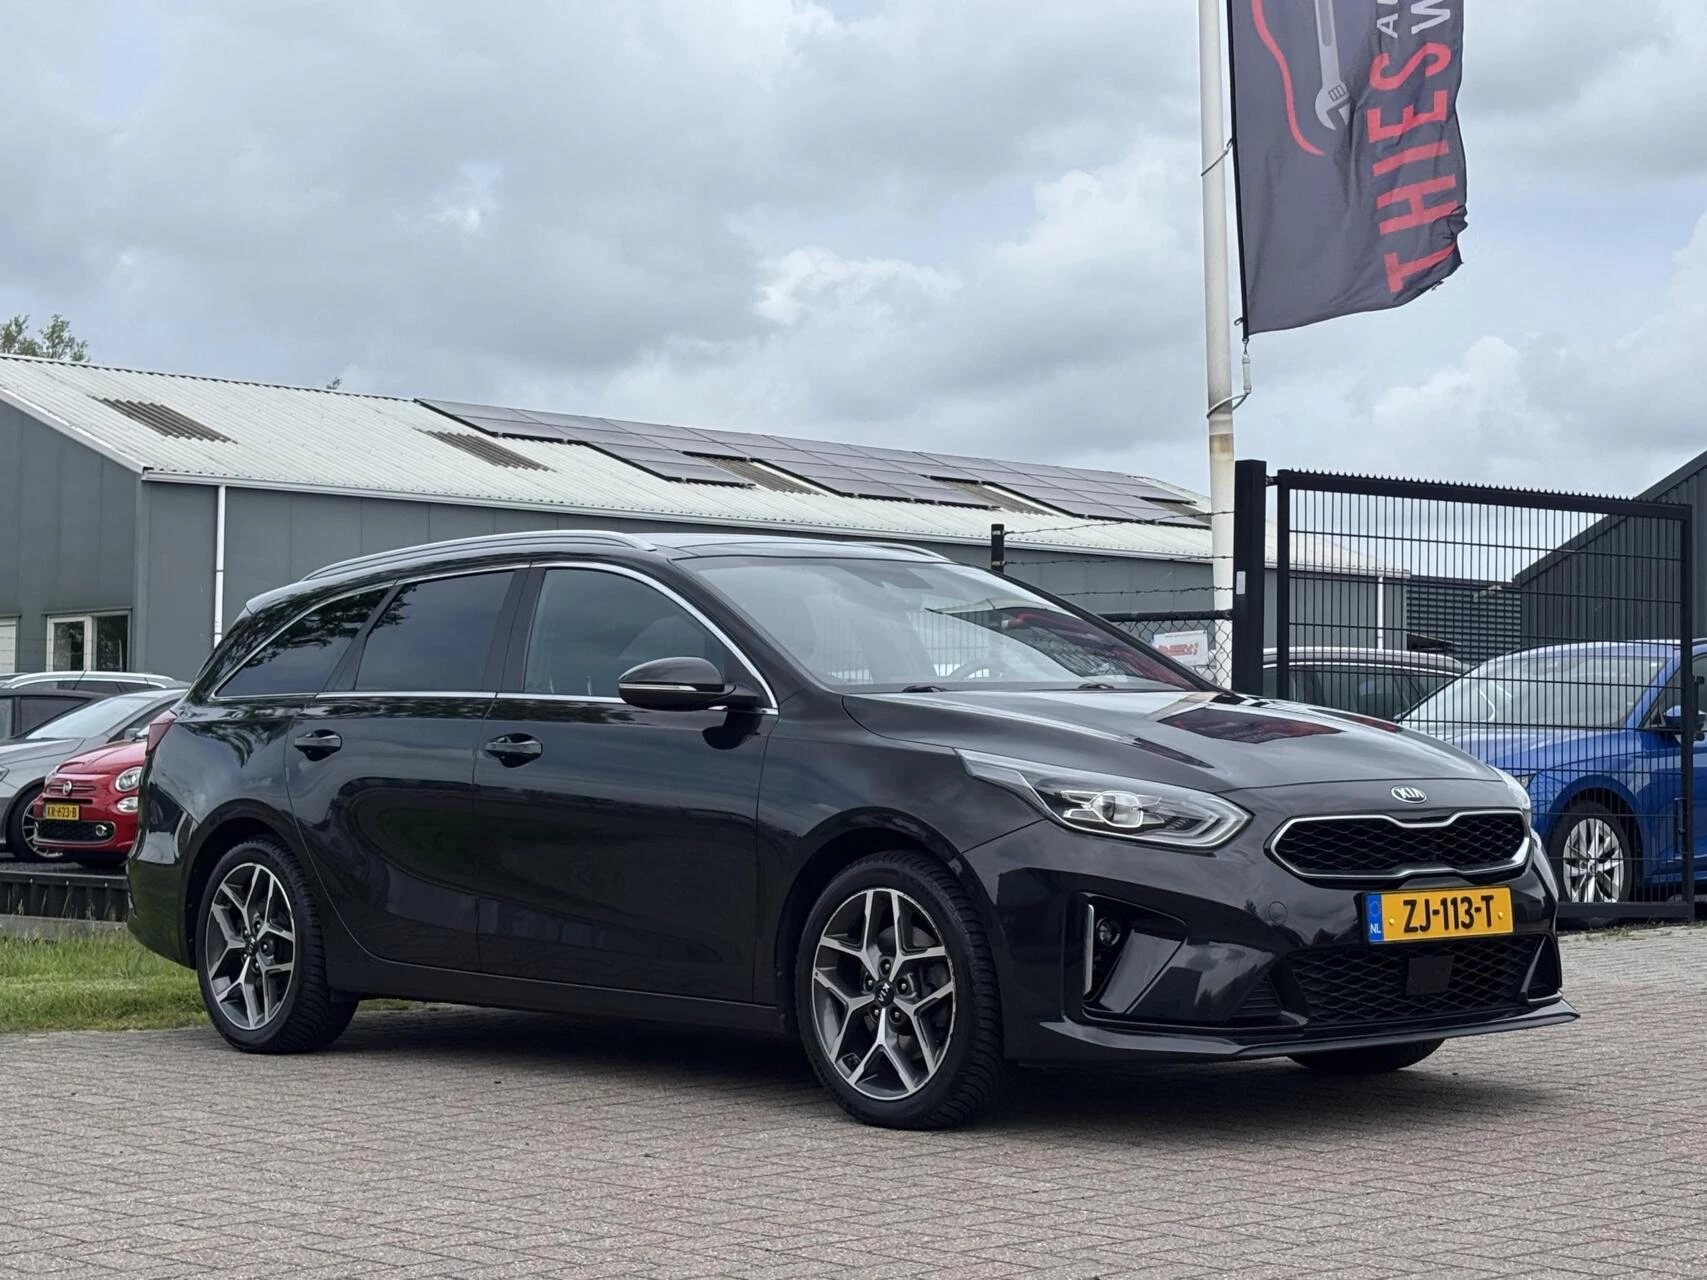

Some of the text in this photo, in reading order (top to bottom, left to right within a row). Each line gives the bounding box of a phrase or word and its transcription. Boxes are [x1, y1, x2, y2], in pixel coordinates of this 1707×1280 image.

[1376, 0, 1398, 38] A
[1367, 42, 1457, 293] THIES
[1370, 923, 1382, 934] NL
[1403, 895, 1494, 933] ZJ-113-T
